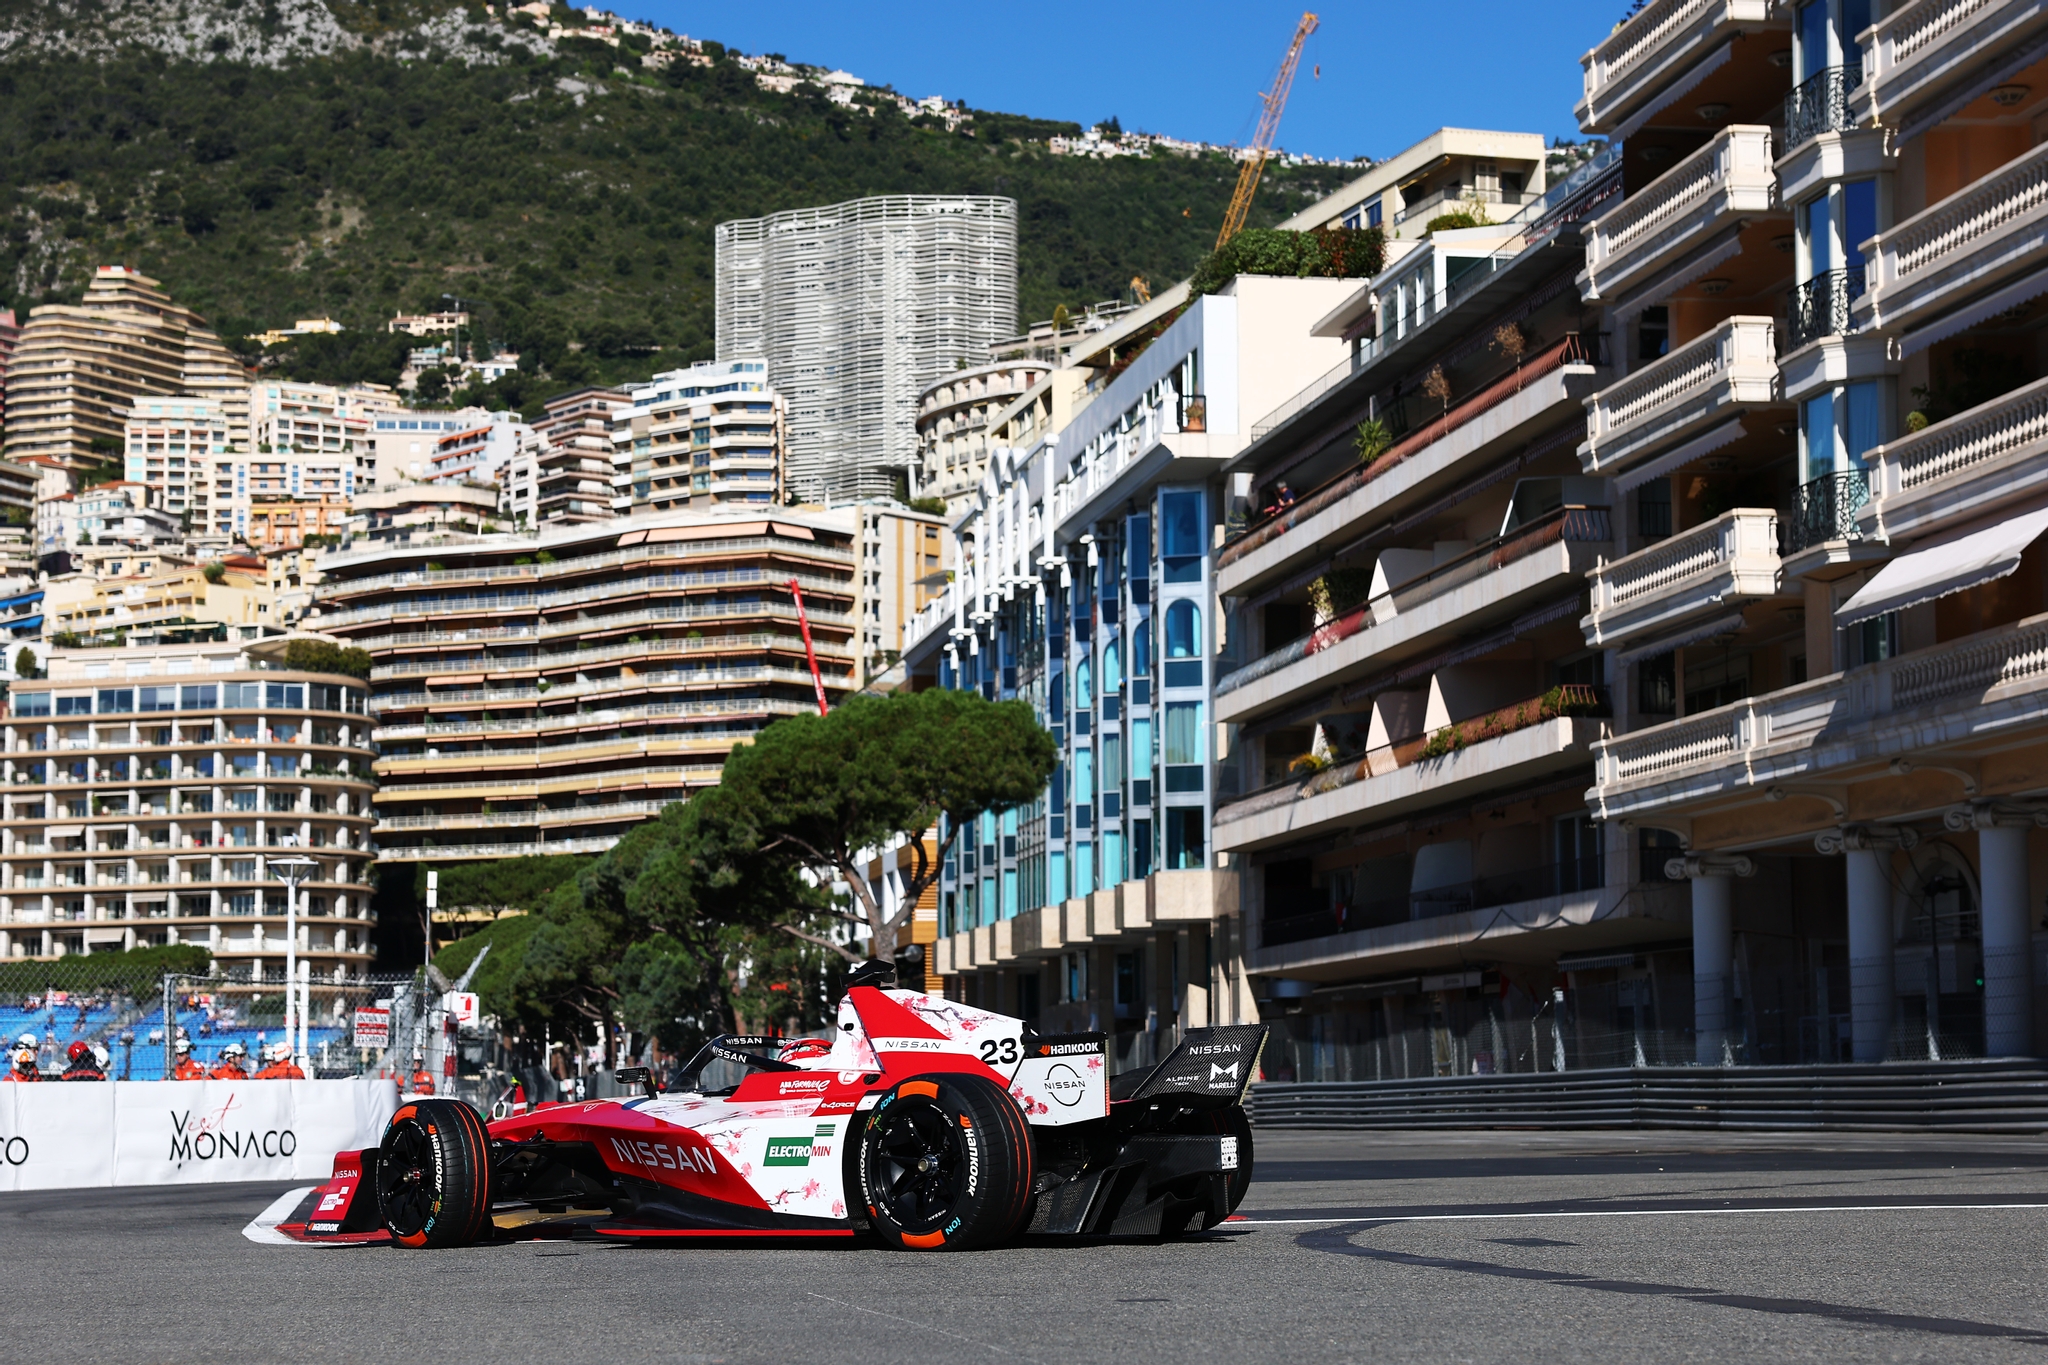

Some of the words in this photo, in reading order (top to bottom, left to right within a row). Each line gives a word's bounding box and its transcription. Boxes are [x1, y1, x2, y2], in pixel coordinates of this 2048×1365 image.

[725, 1037, 763, 1046] NISSAN
[884, 1040, 942, 1050] NISSAN
[712, 1045, 747, 1064] NISSAN
[979, 1037, 1018, 1066] 23
[1189, 1043, 1242, 1056] NISSAN
[1044, 1080, 1086, 1091] NISSAN
[1208, 1081, 1237, 1089] MARELLI
[170, 1092, 242, 1141] Visit
[168, 1129, 297, 1162] MONACO
[768, 1145, 831, 1158] ELECTROMIN
[610, 1137, 717, 1174] NISSAN
[334, 1169, 358, 1179] NISSAN
